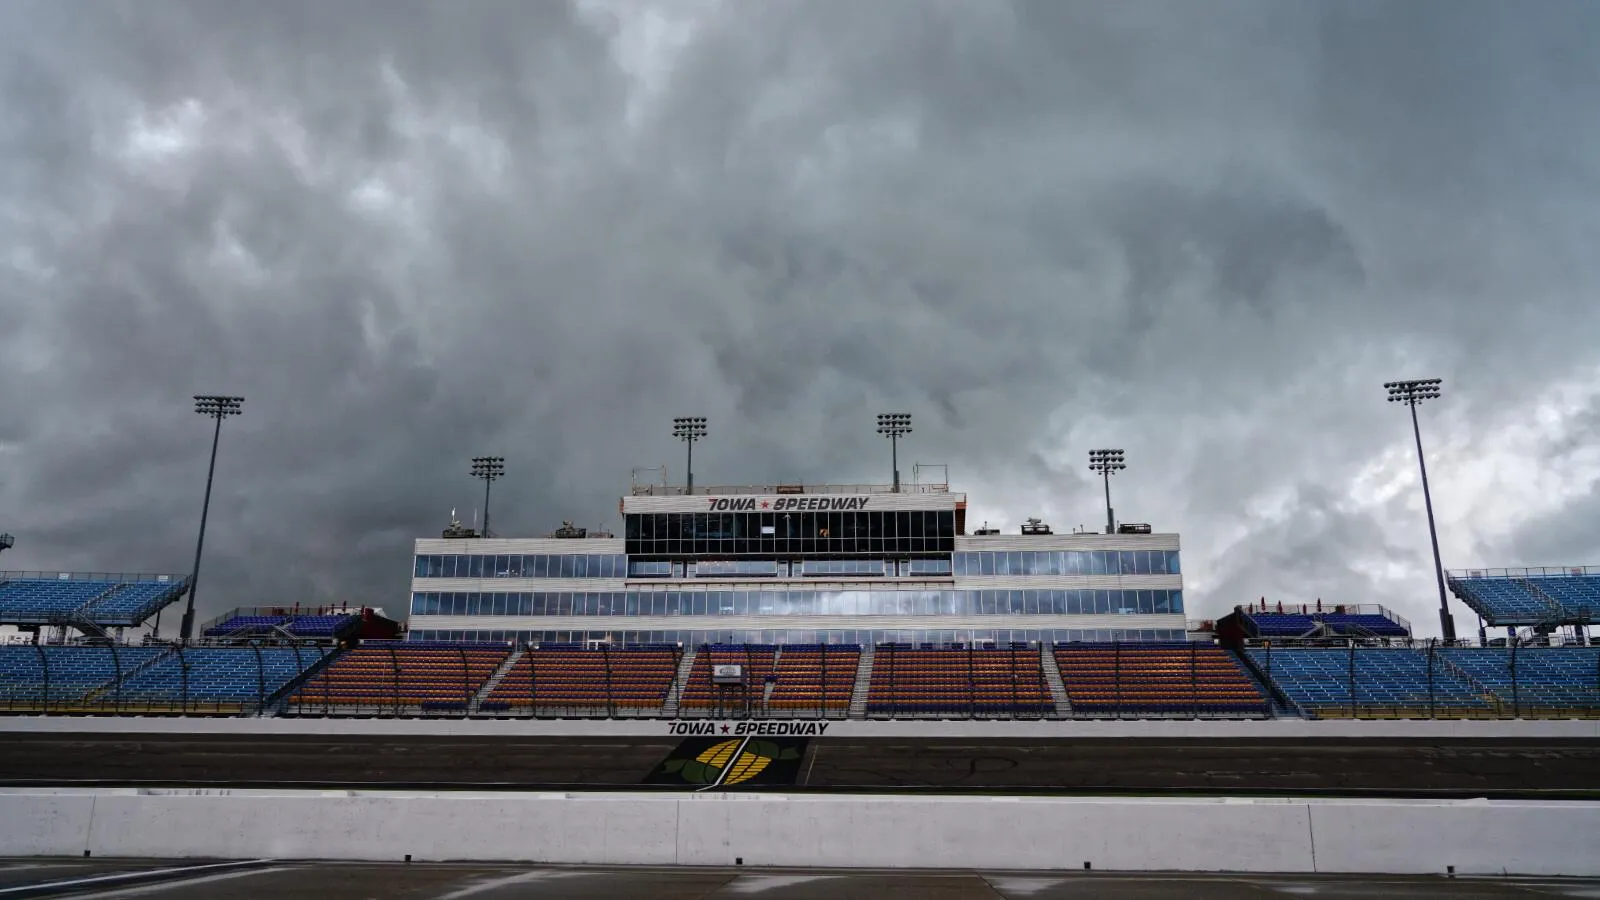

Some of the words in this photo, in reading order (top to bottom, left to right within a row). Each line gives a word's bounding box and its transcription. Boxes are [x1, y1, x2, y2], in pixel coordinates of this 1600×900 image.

[708, 498, 756, 511] IOWA
[773, 497, 870, 511] SPEEDWAY
[668, 722, 715, 735] IOWA
[734, 722, 829, 735] SPEEDWAY
